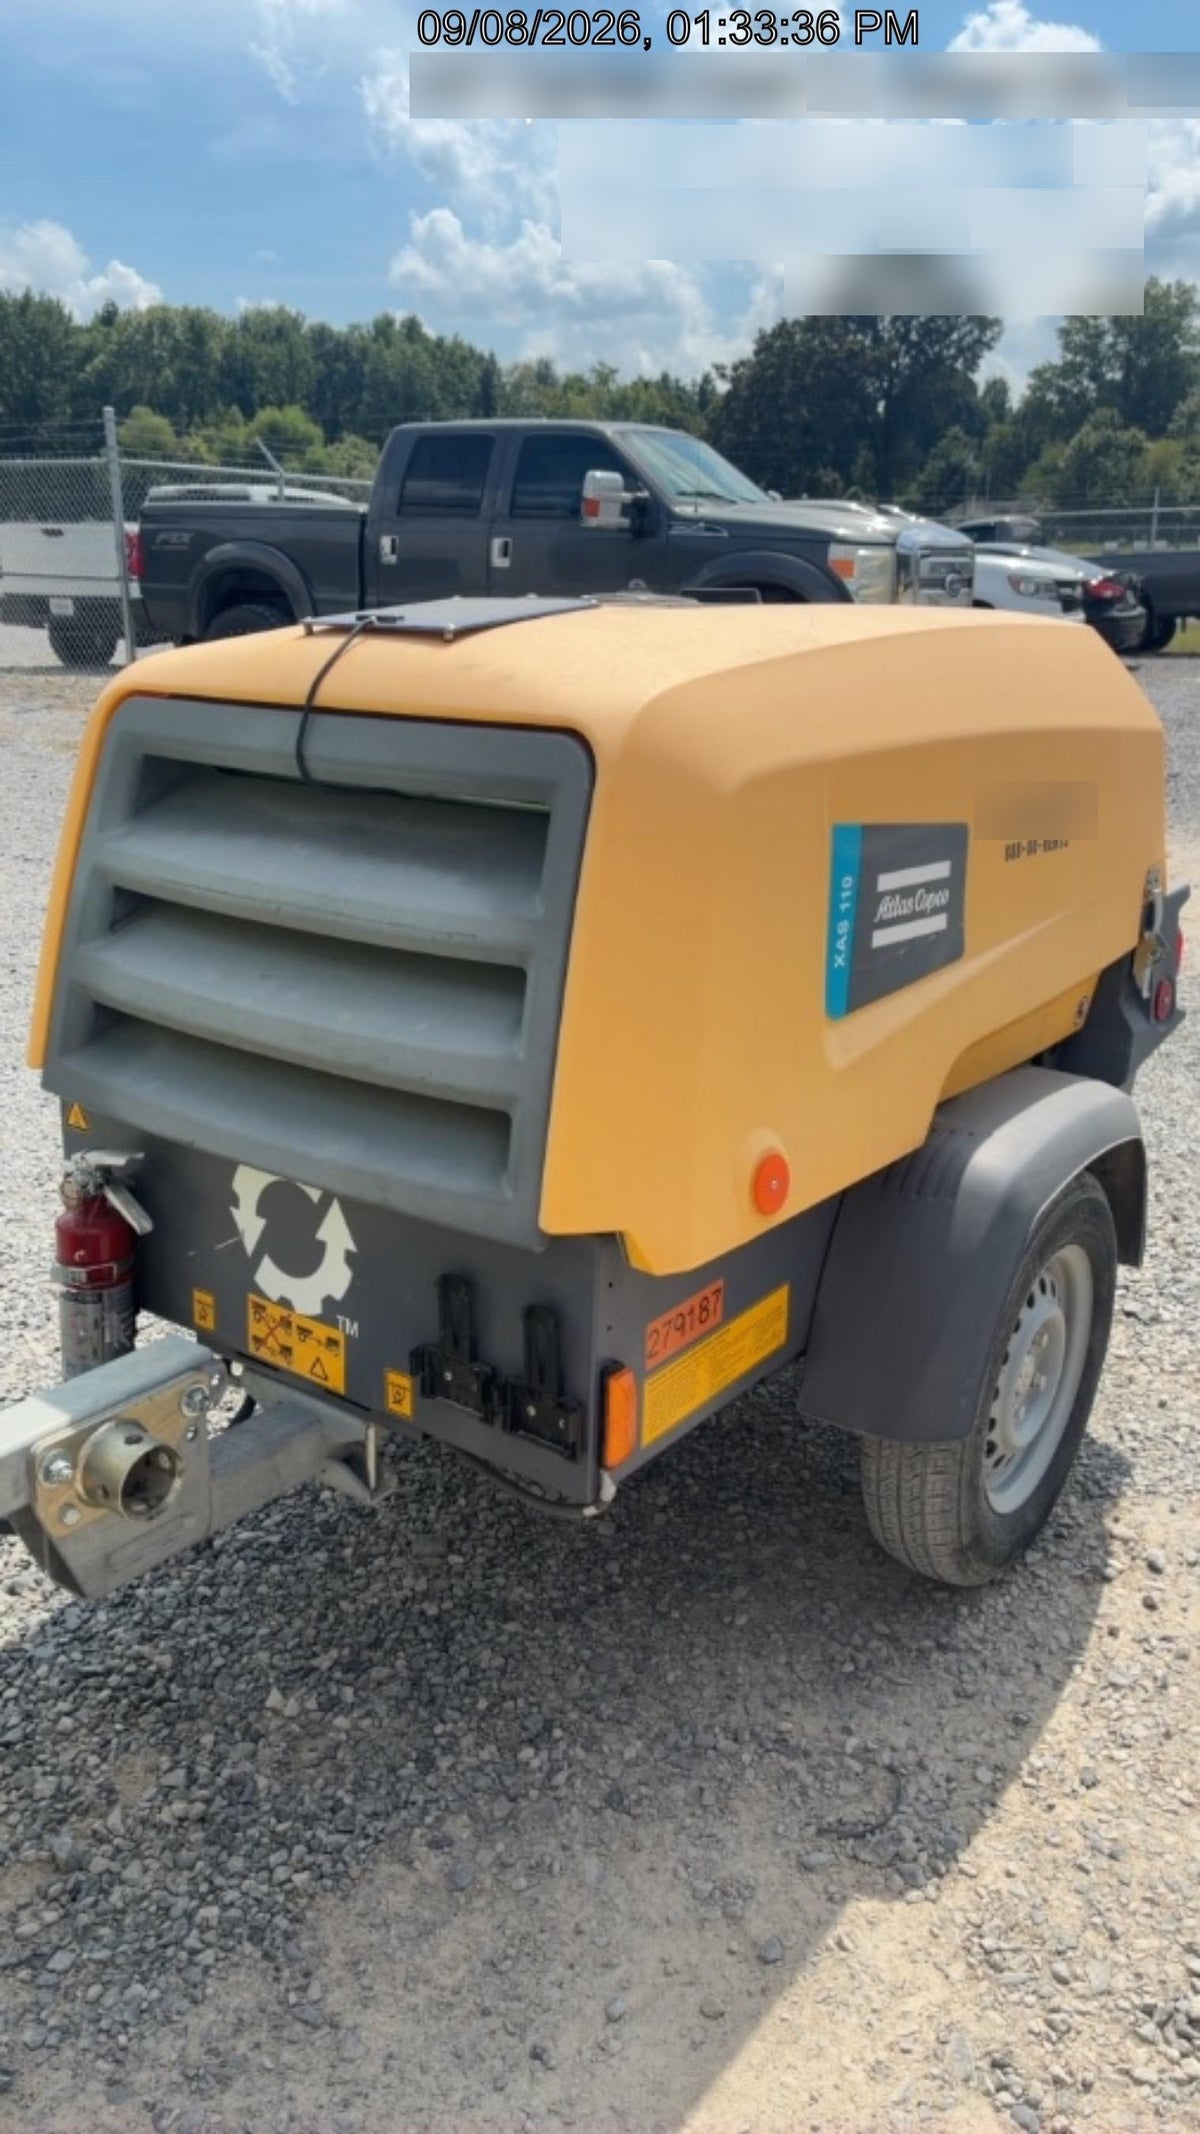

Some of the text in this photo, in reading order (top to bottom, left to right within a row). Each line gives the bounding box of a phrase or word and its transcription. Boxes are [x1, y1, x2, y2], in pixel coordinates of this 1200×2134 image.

[834, 876, 853, 968] XAS 110
[873, 888, 950, 923] Atlas Copco
[336, 1314, 359, 1338] TM
[647, 1287, 722, 1359] 279187
